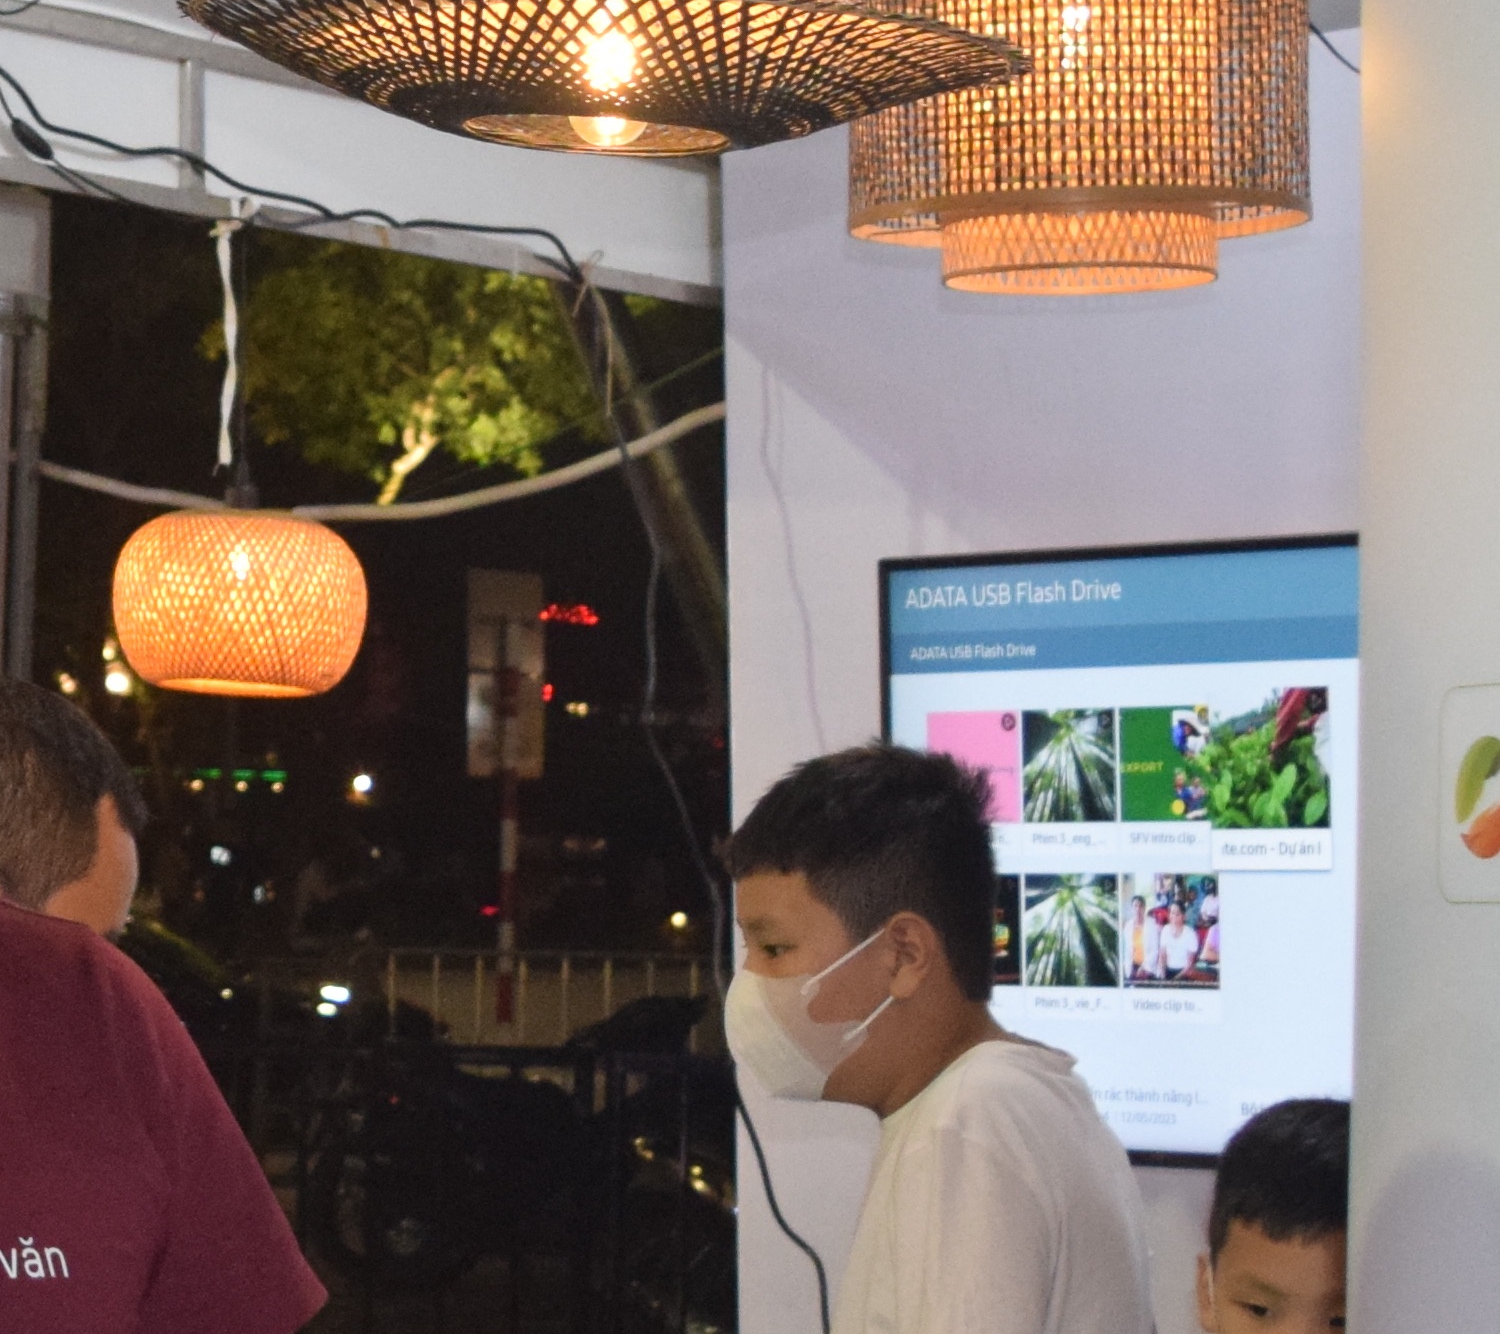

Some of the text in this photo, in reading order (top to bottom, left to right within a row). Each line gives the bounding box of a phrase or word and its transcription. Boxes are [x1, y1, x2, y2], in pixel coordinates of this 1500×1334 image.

[906, 578, 1122, 610] ADATA USB Flash Drive
[910, 643, 1037, 661] ADATA USB Flash Drive
